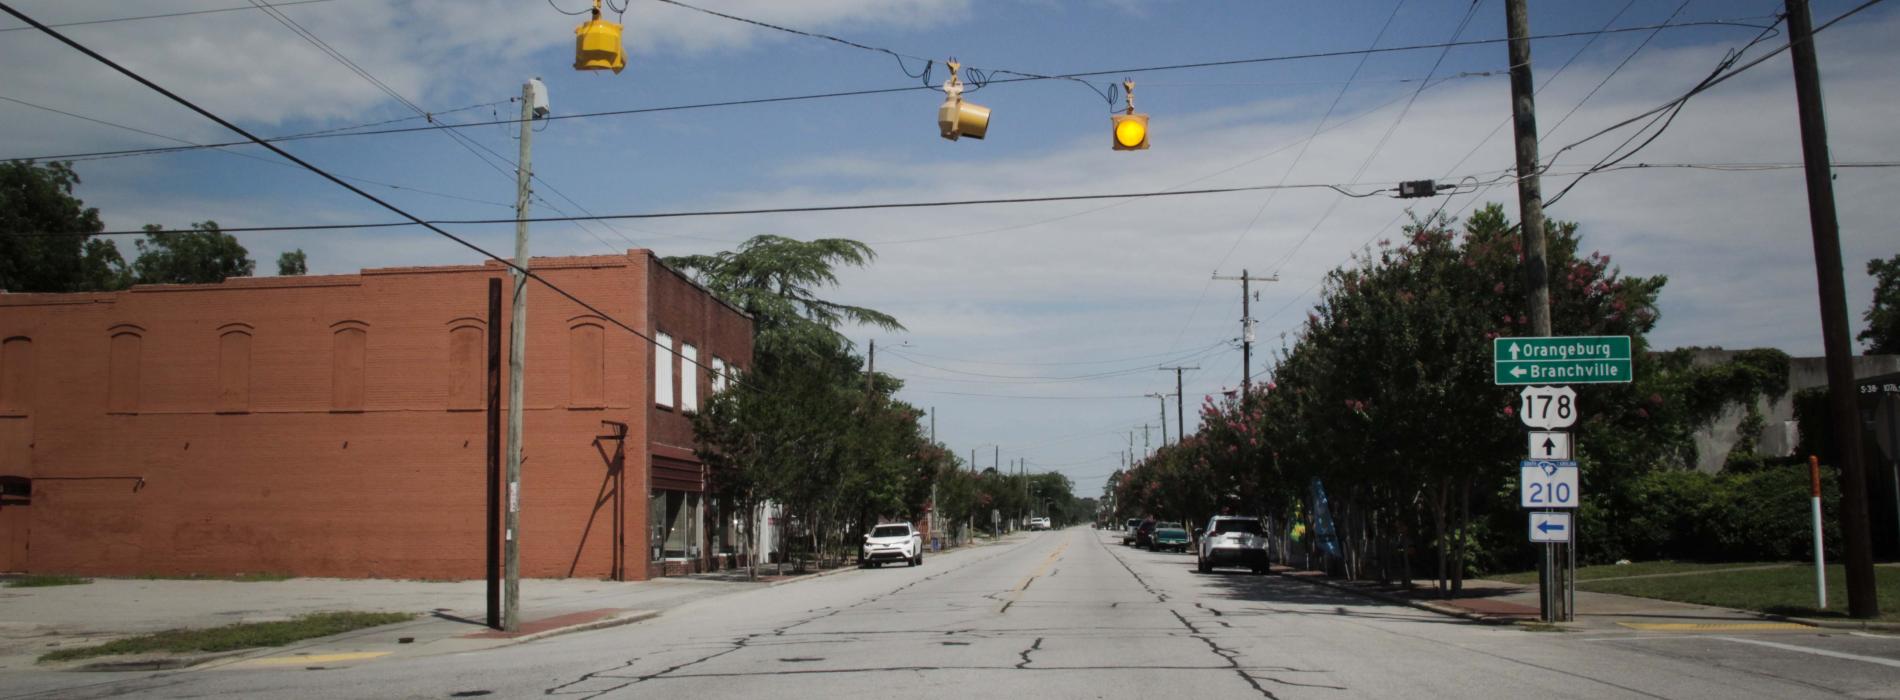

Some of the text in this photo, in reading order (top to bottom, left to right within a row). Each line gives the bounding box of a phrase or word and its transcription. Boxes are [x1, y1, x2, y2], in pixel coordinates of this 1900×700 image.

[1523, 343, 1610, 359] Orangeburg
[1530, 363, 1618, 378] Branchville
[1526, 395, 1571, 419] 178
[1529, 483, 1570, 503] 210
